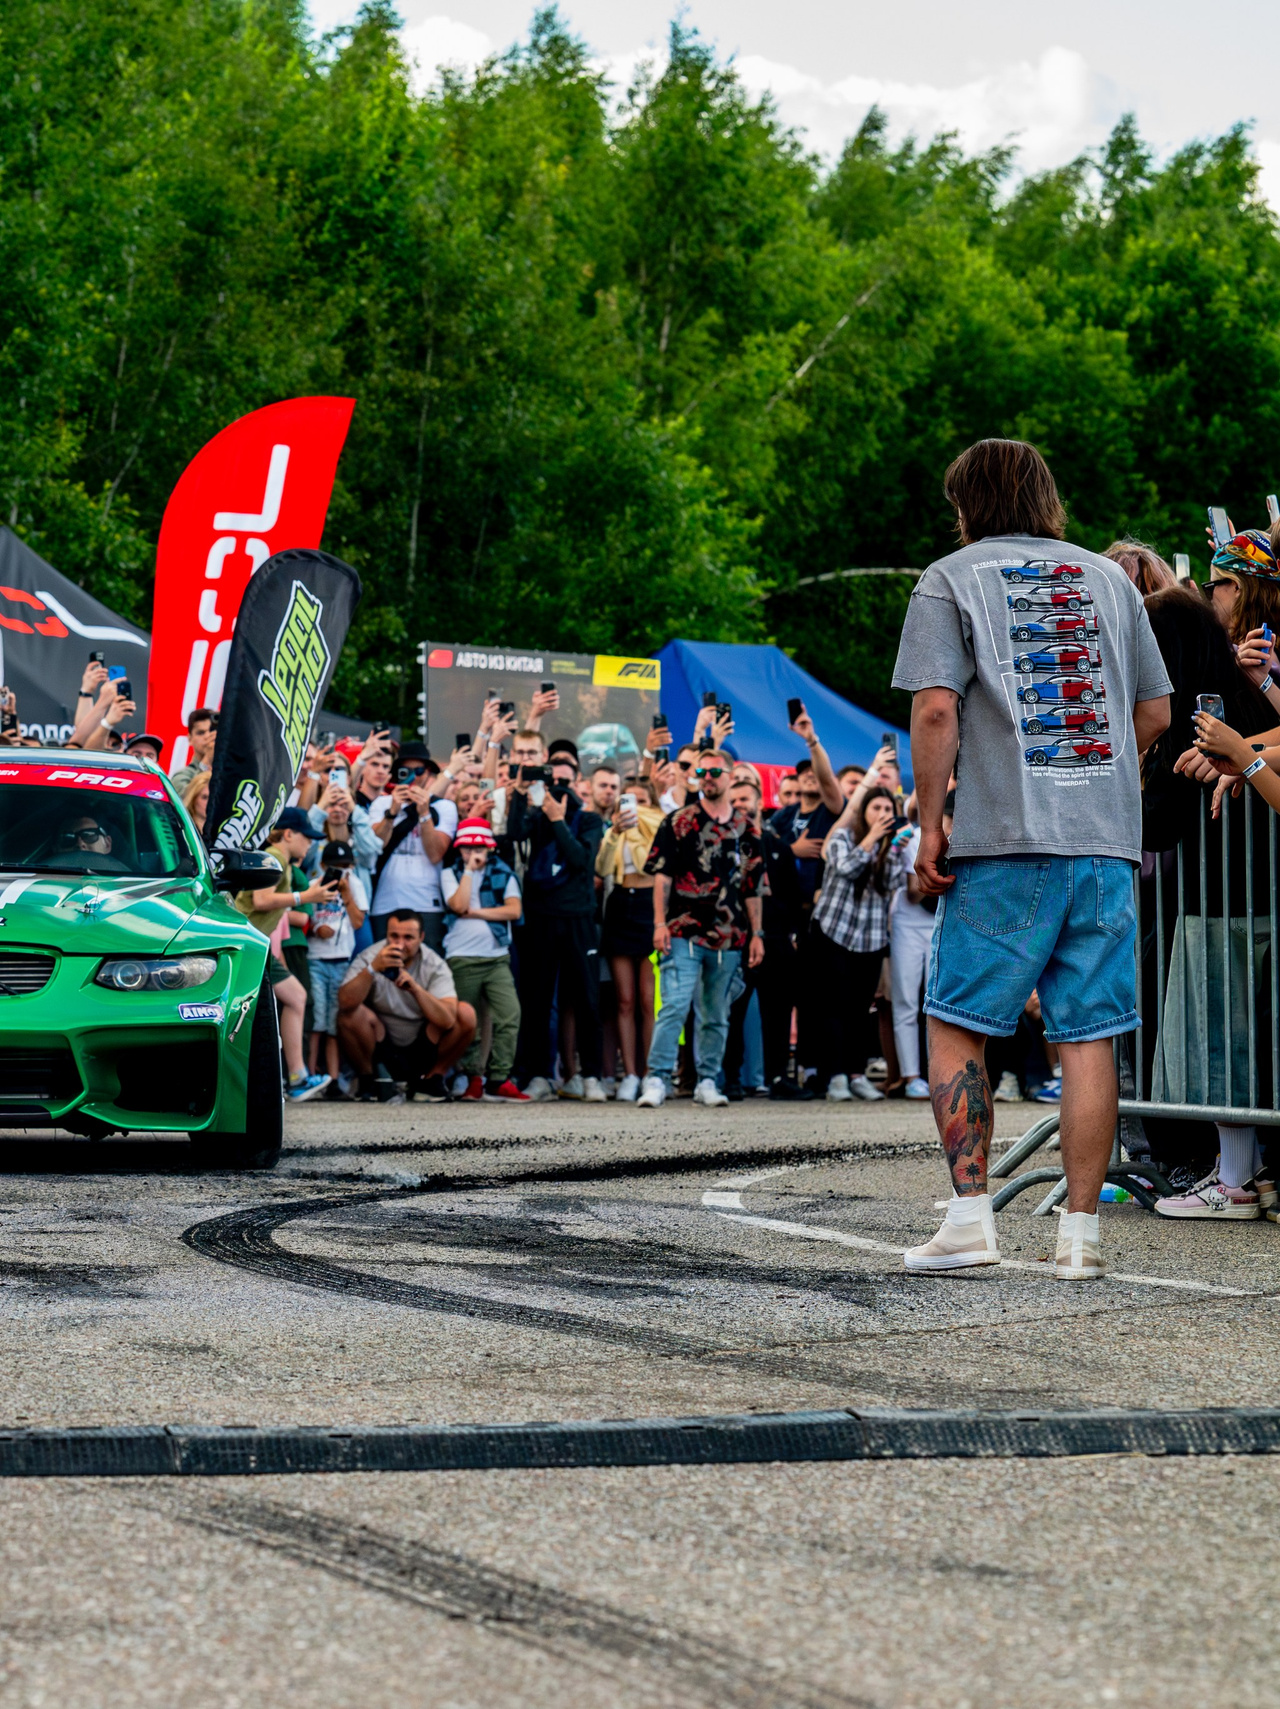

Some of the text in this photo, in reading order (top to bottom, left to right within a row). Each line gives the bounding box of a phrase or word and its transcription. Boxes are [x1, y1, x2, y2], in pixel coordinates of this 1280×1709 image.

[456, 652, 487, 669] АВТО
[488, 654, 505, 670] ИЗ
[505, 655, 544, 673] КИТАЯ
[47, 770, 133, 788] PRO
